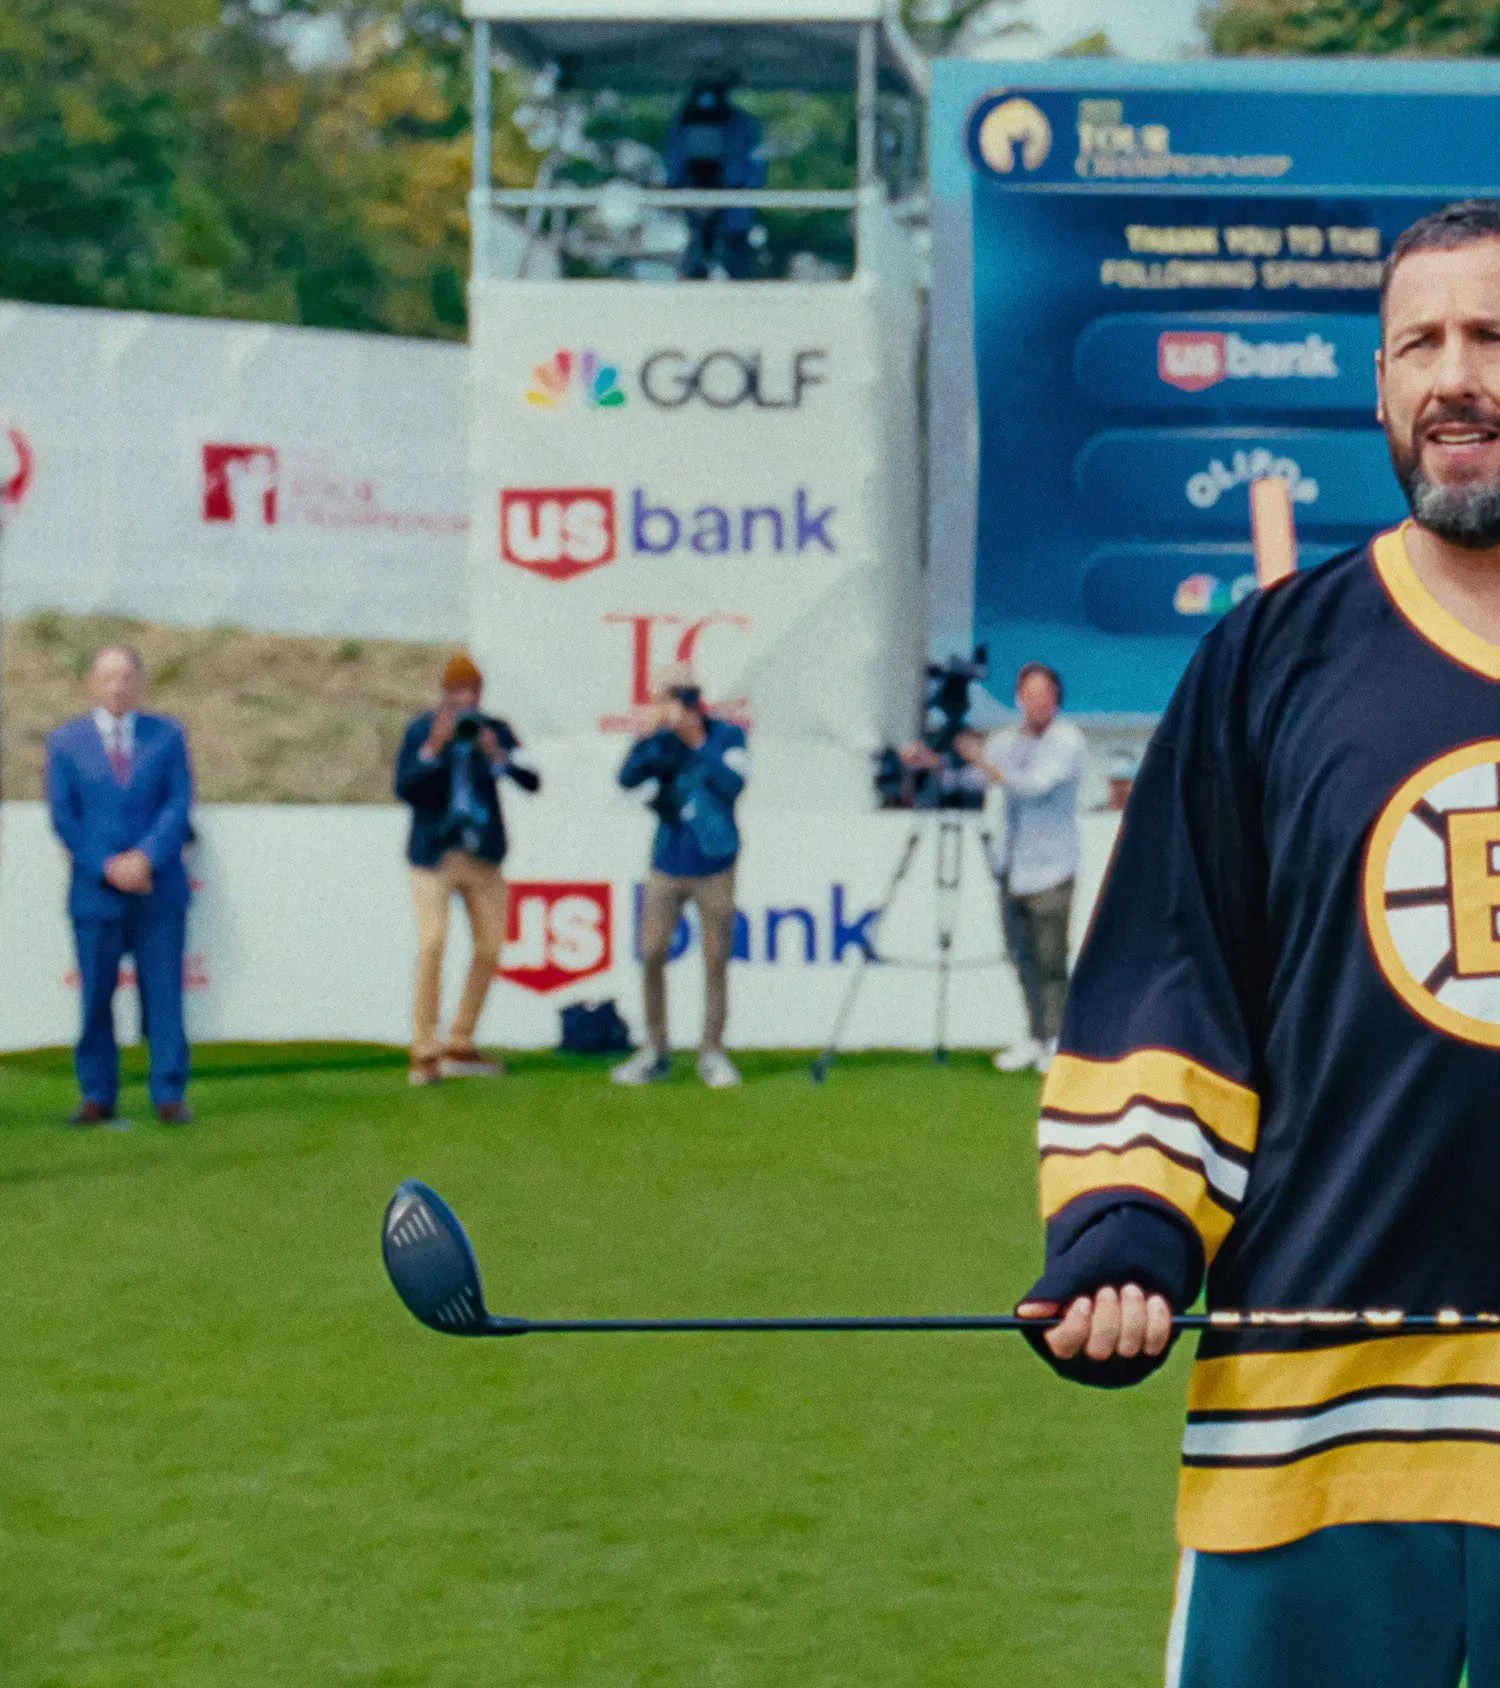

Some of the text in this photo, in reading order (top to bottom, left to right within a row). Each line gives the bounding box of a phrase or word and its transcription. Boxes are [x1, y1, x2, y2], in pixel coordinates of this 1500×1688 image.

[1224, 226, 1283, 256] YOU
[1287, 226, 1324, 255] TO
[1329, 227, 1381, 255] THE
[1262, 261, 1386, 289] SPONSOR
[640, 350, 828, 408] GOLF
[1226, 332, 1338, 379] bank
[632, 488, 837, 554] bank
[604, 613, 752, 716] TC
